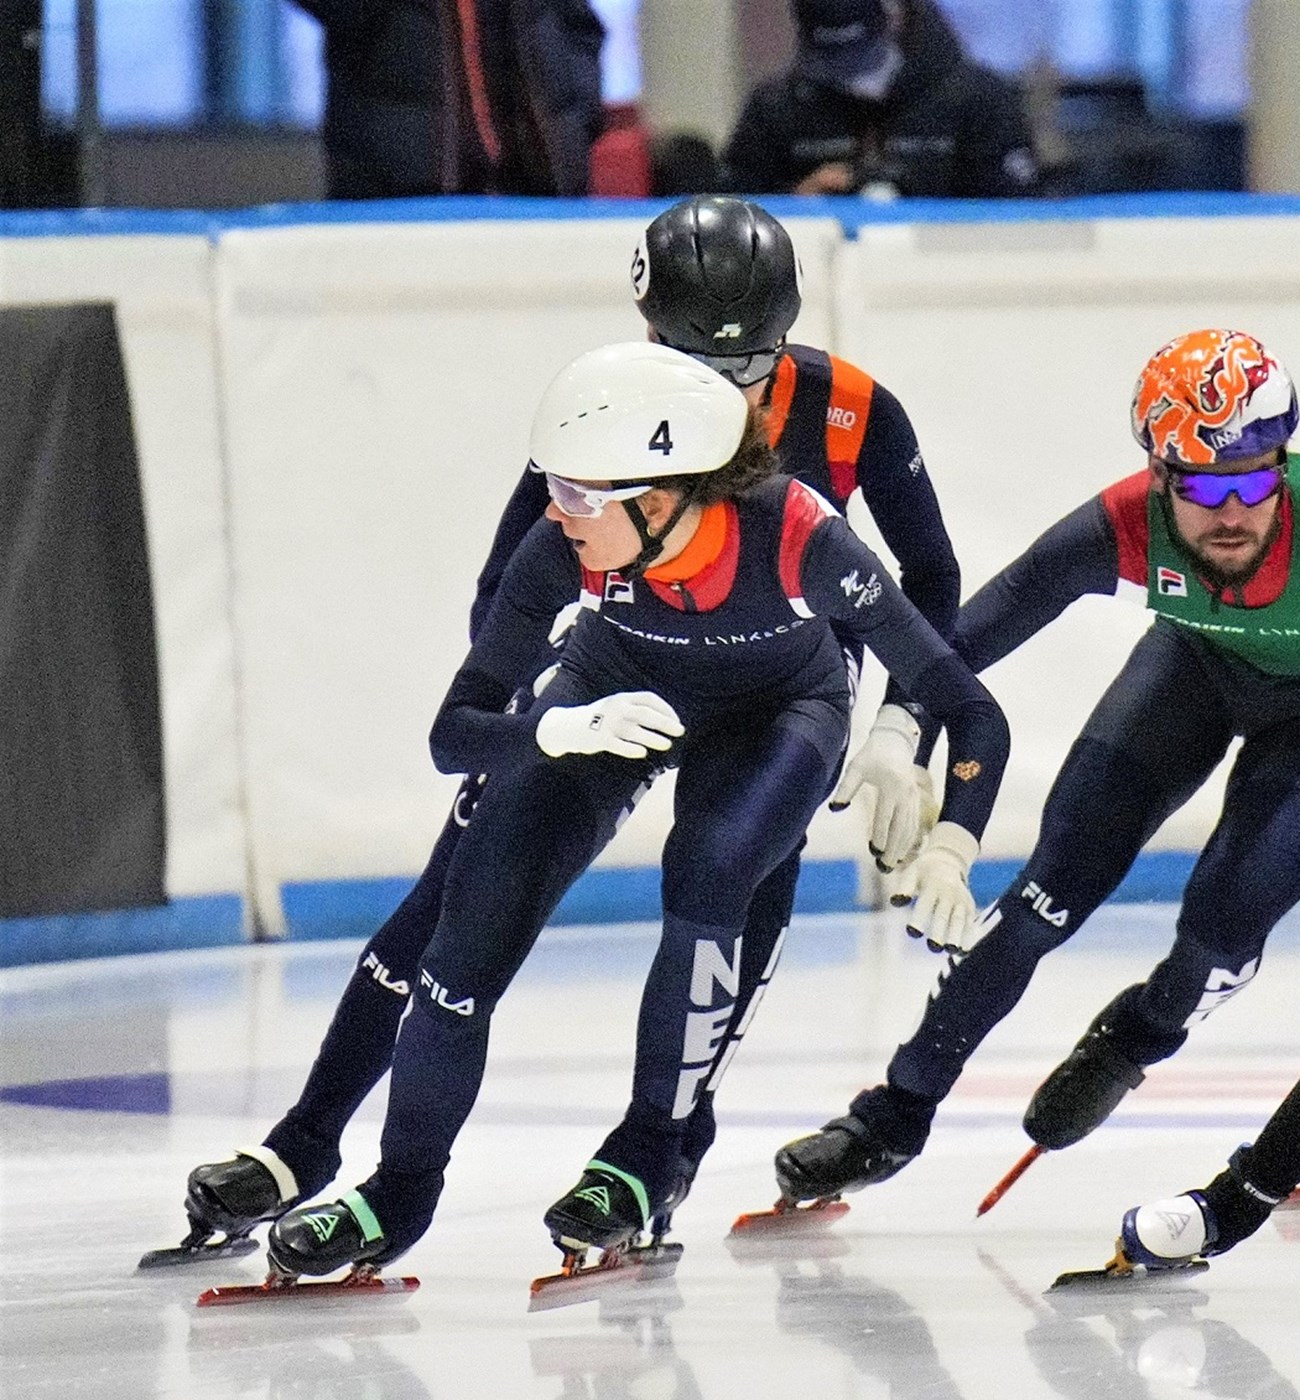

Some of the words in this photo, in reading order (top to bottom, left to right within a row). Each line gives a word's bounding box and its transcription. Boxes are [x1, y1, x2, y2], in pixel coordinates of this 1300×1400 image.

[648, 420, 673, 455] 4
[1021, 881, 1069, 928] FILA
[362, 951, 410, 995] FILA
[420, 967, 475, 1016] FILA
